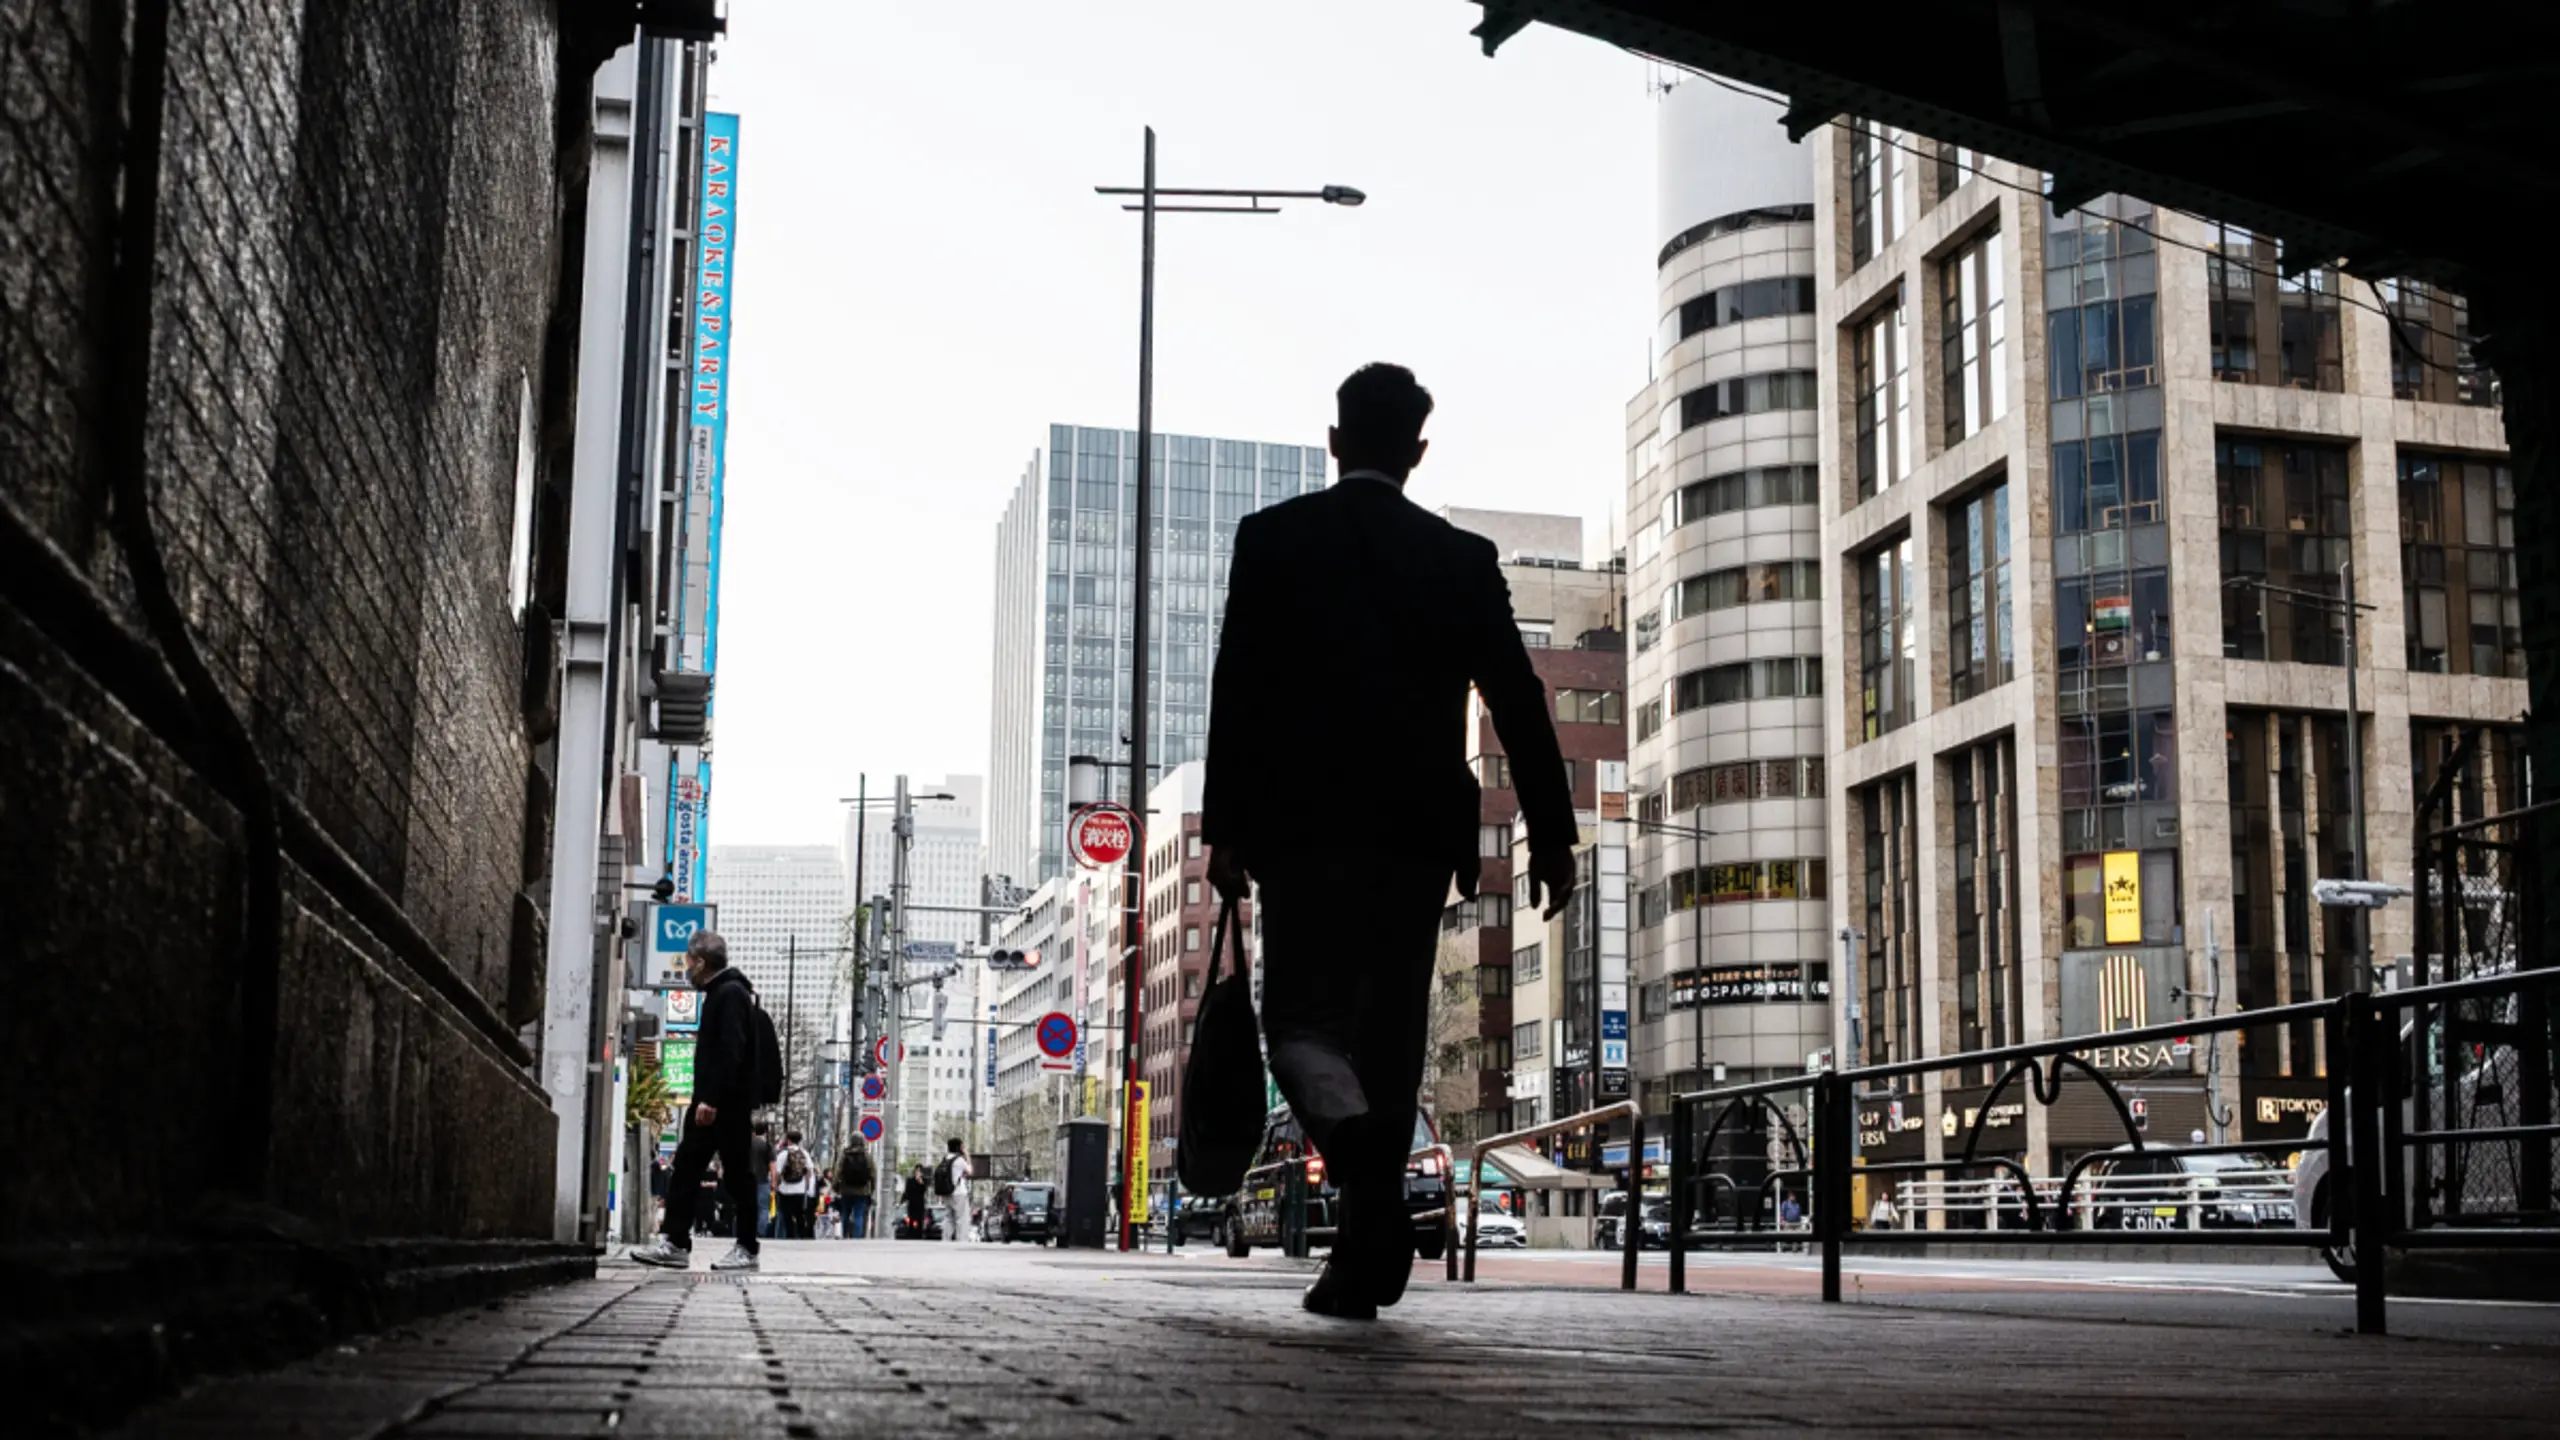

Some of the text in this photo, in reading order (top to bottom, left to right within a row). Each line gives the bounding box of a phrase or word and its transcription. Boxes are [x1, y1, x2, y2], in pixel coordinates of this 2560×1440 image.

[697, 135, 730, 420] KARAOKE&PARTY
[677, 801, 693, 845] gosta
[1084, 826, 1127, 848] 消火栓
[676, 848, 691, 893] annex
[2280, 1098, 2322, 1112] TOKYO
